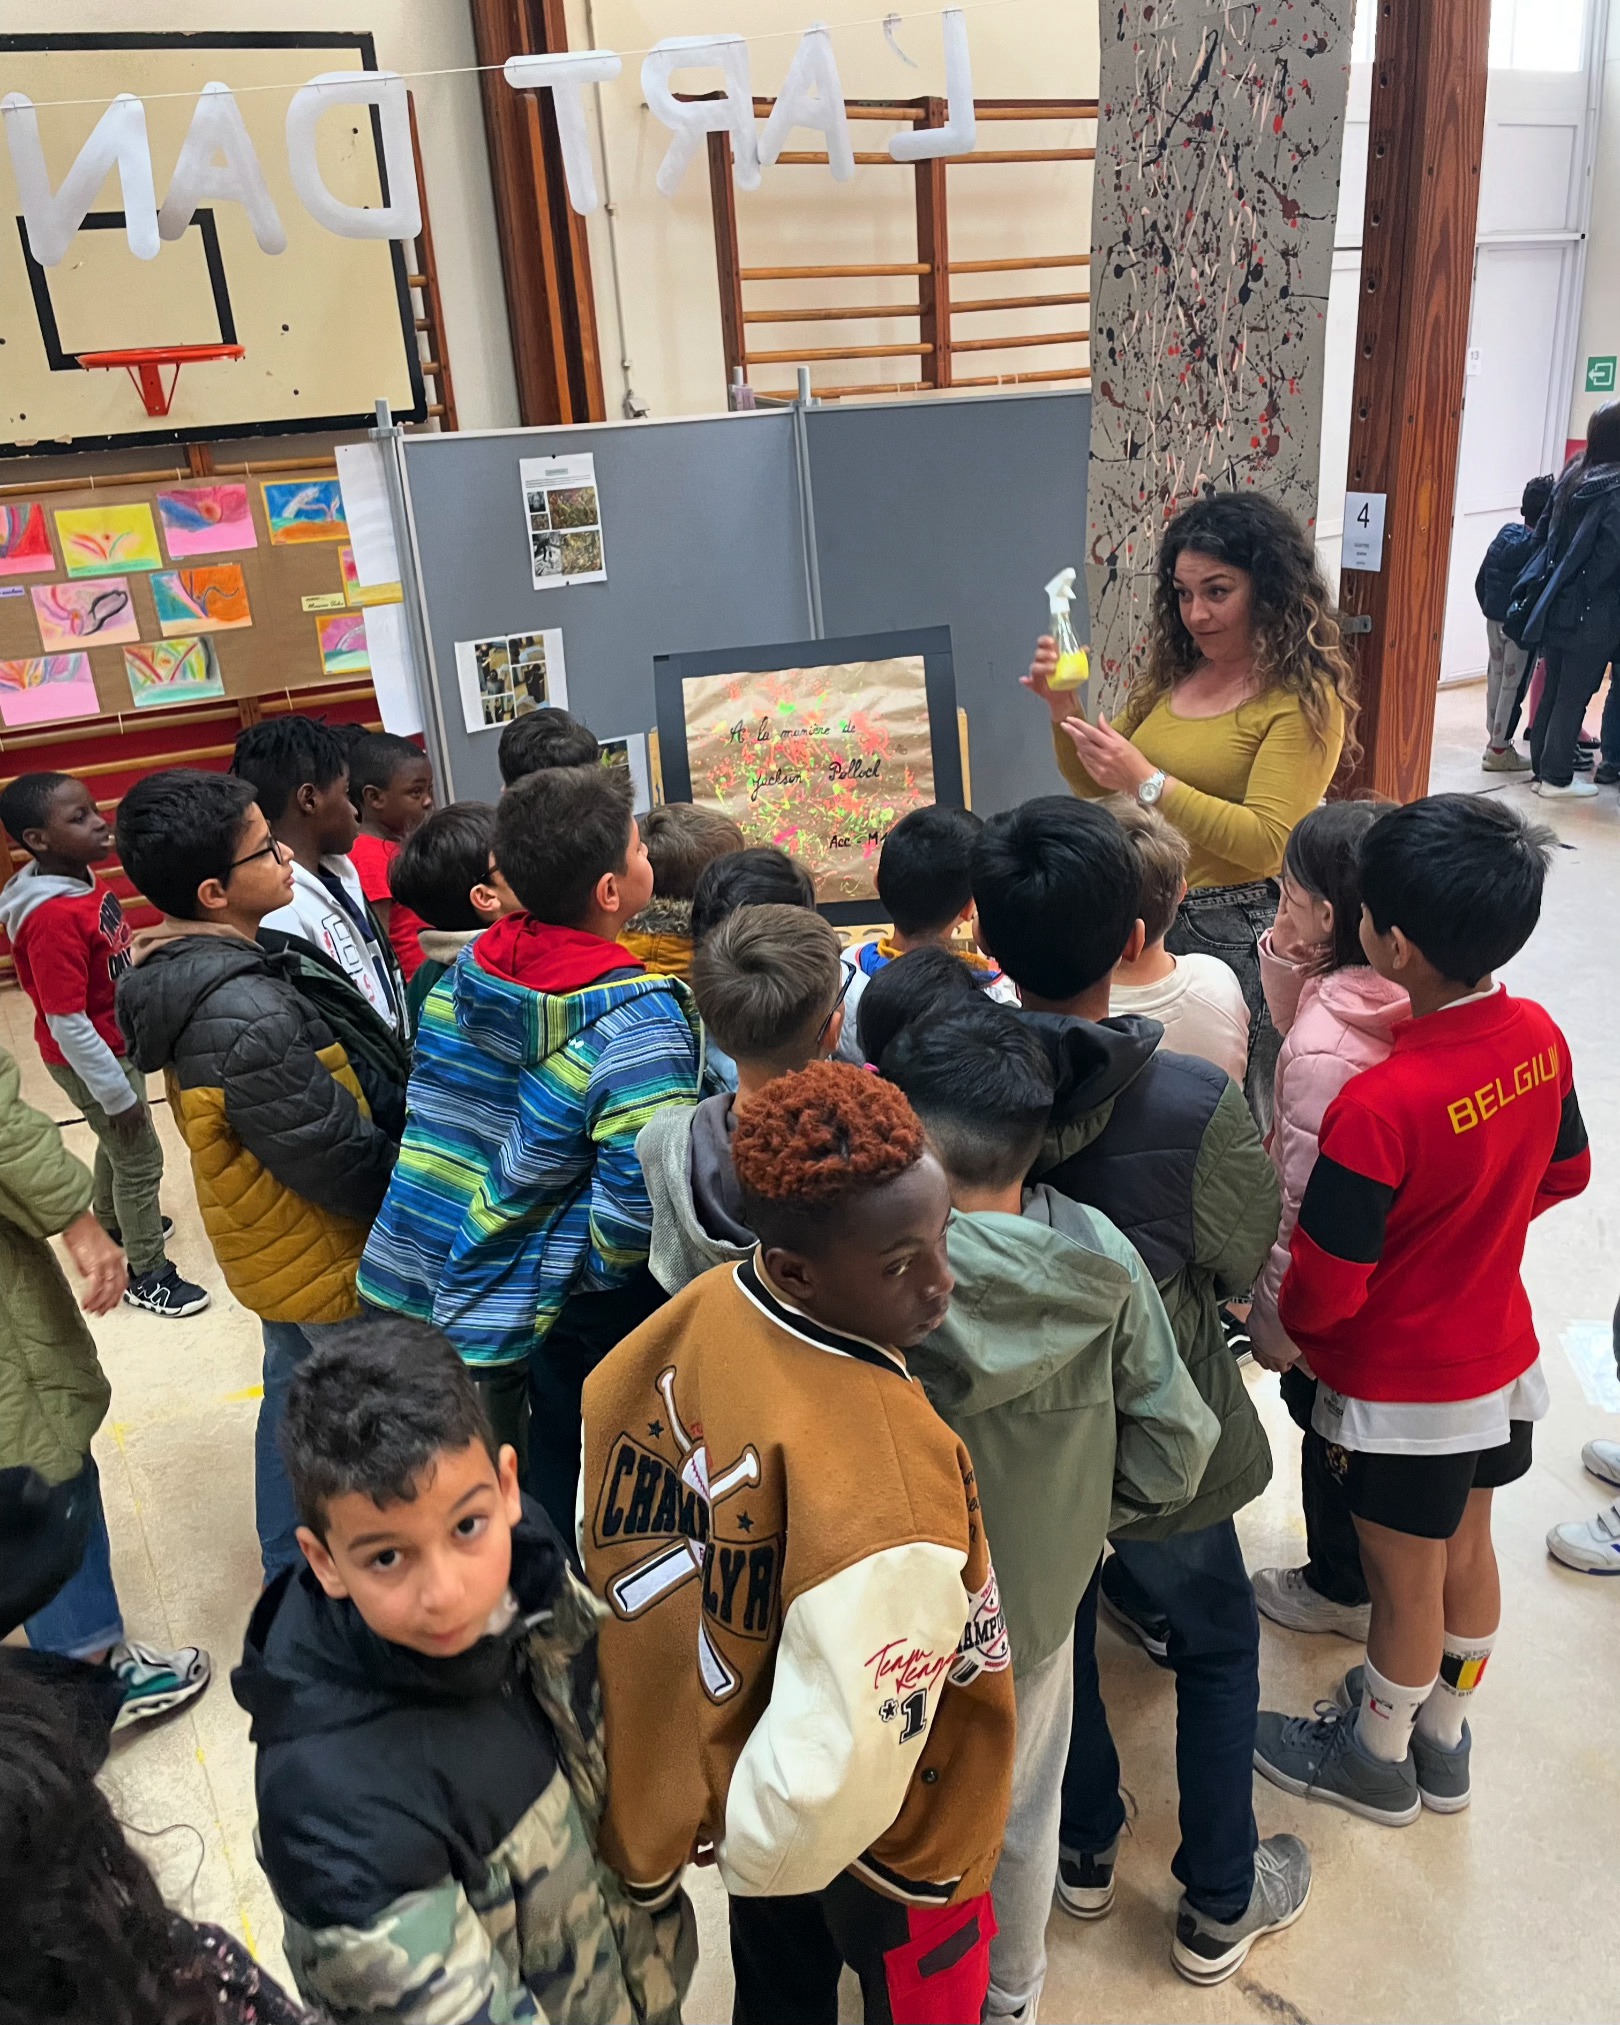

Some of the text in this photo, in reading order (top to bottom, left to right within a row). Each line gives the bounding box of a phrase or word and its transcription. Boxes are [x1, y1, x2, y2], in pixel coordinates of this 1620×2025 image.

[1356, 502, 1370, 529] 4
[757, 716, 771, 742] la
[841, 718, 857, 733] de
